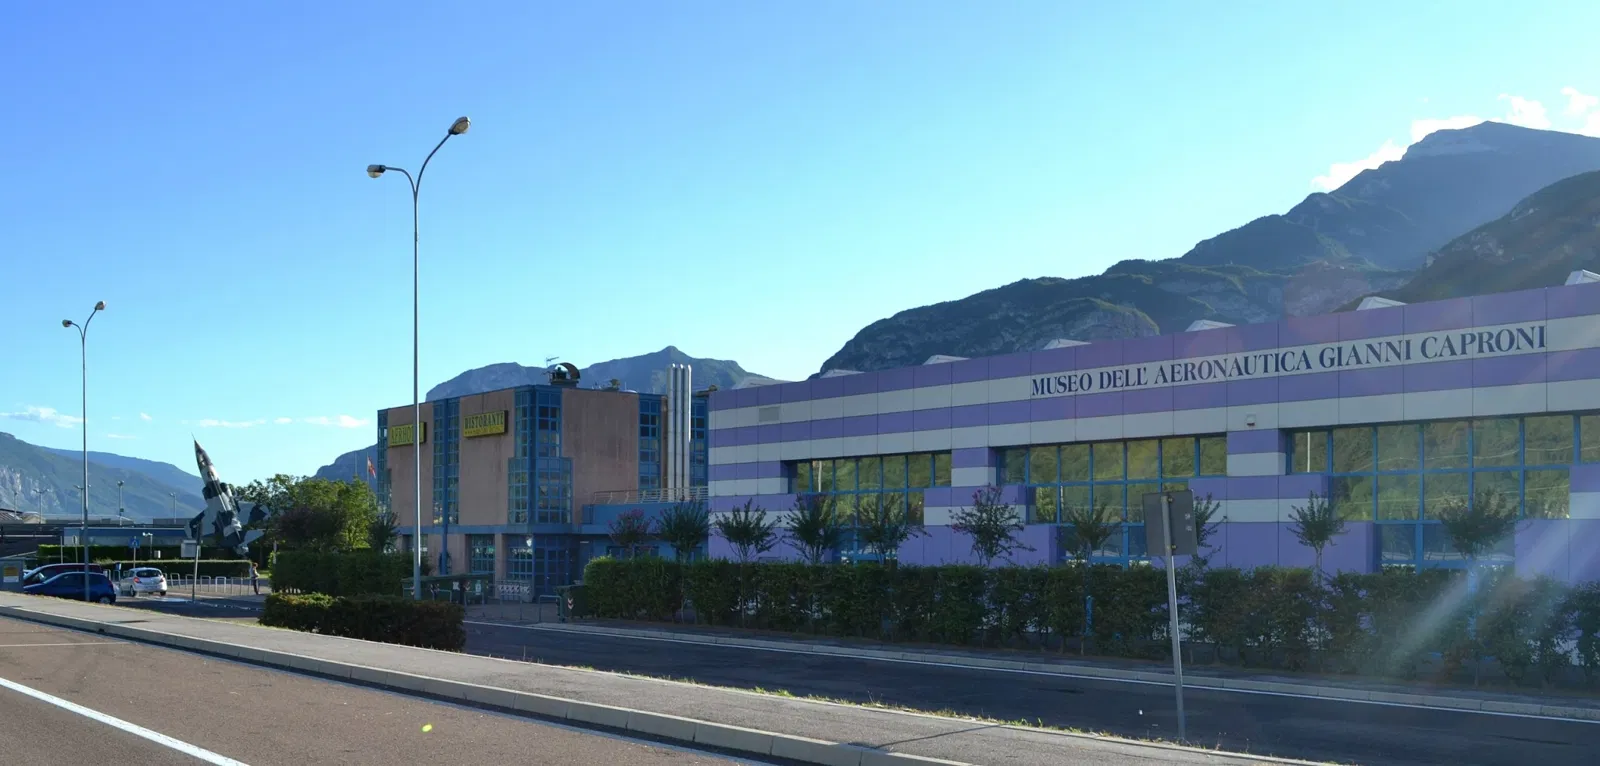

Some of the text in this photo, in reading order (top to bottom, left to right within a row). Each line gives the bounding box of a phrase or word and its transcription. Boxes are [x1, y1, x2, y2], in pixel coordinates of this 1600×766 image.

[1031, 325, 1546, 396] MUSEO DELL' AERONAUTICA GIANNI CAPRONI
[464, 411, 504, 430] RISTORANTE
